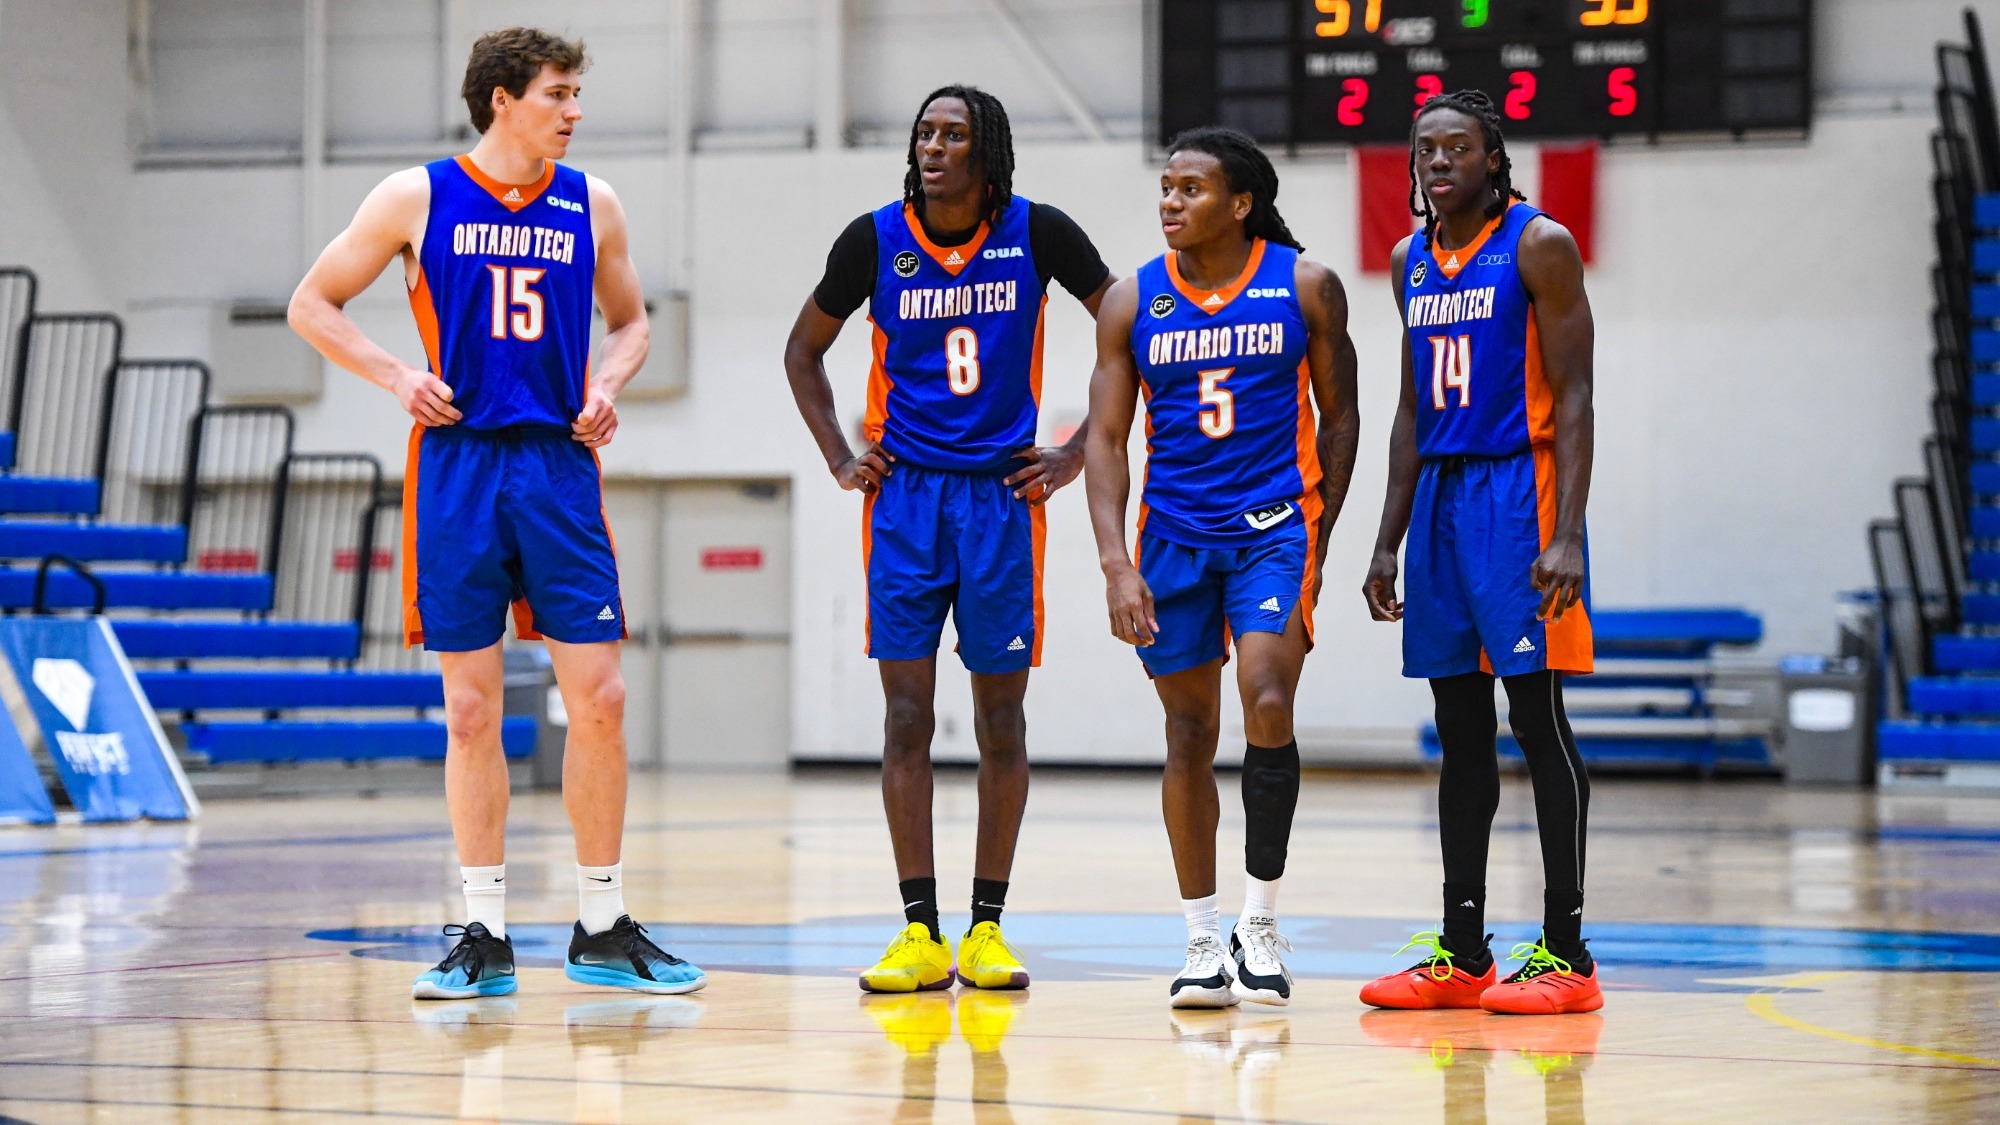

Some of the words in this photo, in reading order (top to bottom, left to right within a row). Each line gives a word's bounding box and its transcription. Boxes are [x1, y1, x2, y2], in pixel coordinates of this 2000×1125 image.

[1338, 78, 1369, 126] 2
[1505, 71, 1537, 120] 2
[1608, 67, 1637, 116] 5
[547, 196, 584, 213] OUA
[453, 223, 531, 257] ONTARIO
[534, 226, 575, 265] TECH
[897, 257, 915, 268] GF
[983, 246, 1024, 259] OUA
[1477, 253, 1510, 265] OUA
[486, 263, 547, 341] 15
[900, 285, 971, 320] ONTARIO
[974, 280, 1017, 314] TECH
[1154, 299, 1173, 311] GF
[1246, 287, 1291, 298] OUA
[1407, 292, 1463, 328] ONTARIO
[1462, 286, 1496, 321] TECH
[944, 325, 981, 396] 8
[1149, 326, 1232, 366] ONTARIO
[1234, 322, 1284, 356] TECH
[1427, 334, 1471, 410] 14
[1197, 366, 1236, 439] 5
